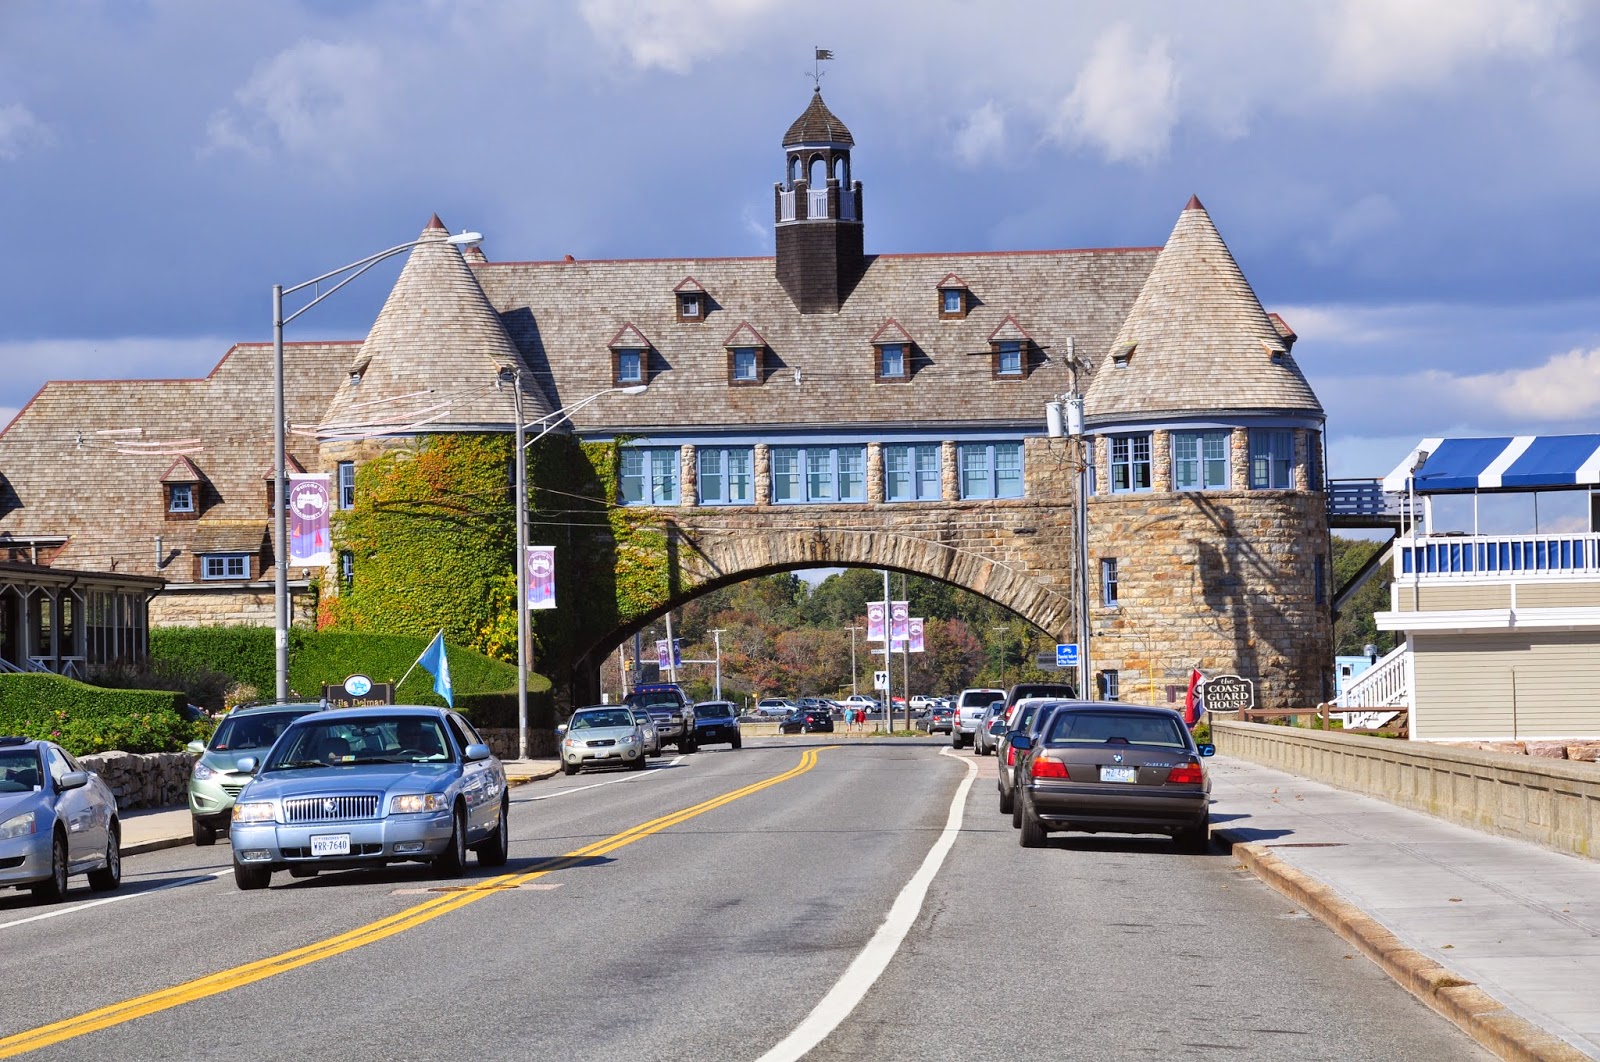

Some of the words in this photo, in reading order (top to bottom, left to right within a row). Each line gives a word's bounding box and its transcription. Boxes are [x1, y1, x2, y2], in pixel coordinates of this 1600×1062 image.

[1220, 677, 1235, 685] the
[1208, 684, 1247, 693] COAST
[1207, 692, 1249, 701] GUARD
[1209, 700, 1248, 709] HOUSE
[313, 840, 347, 851] WRR-7640
